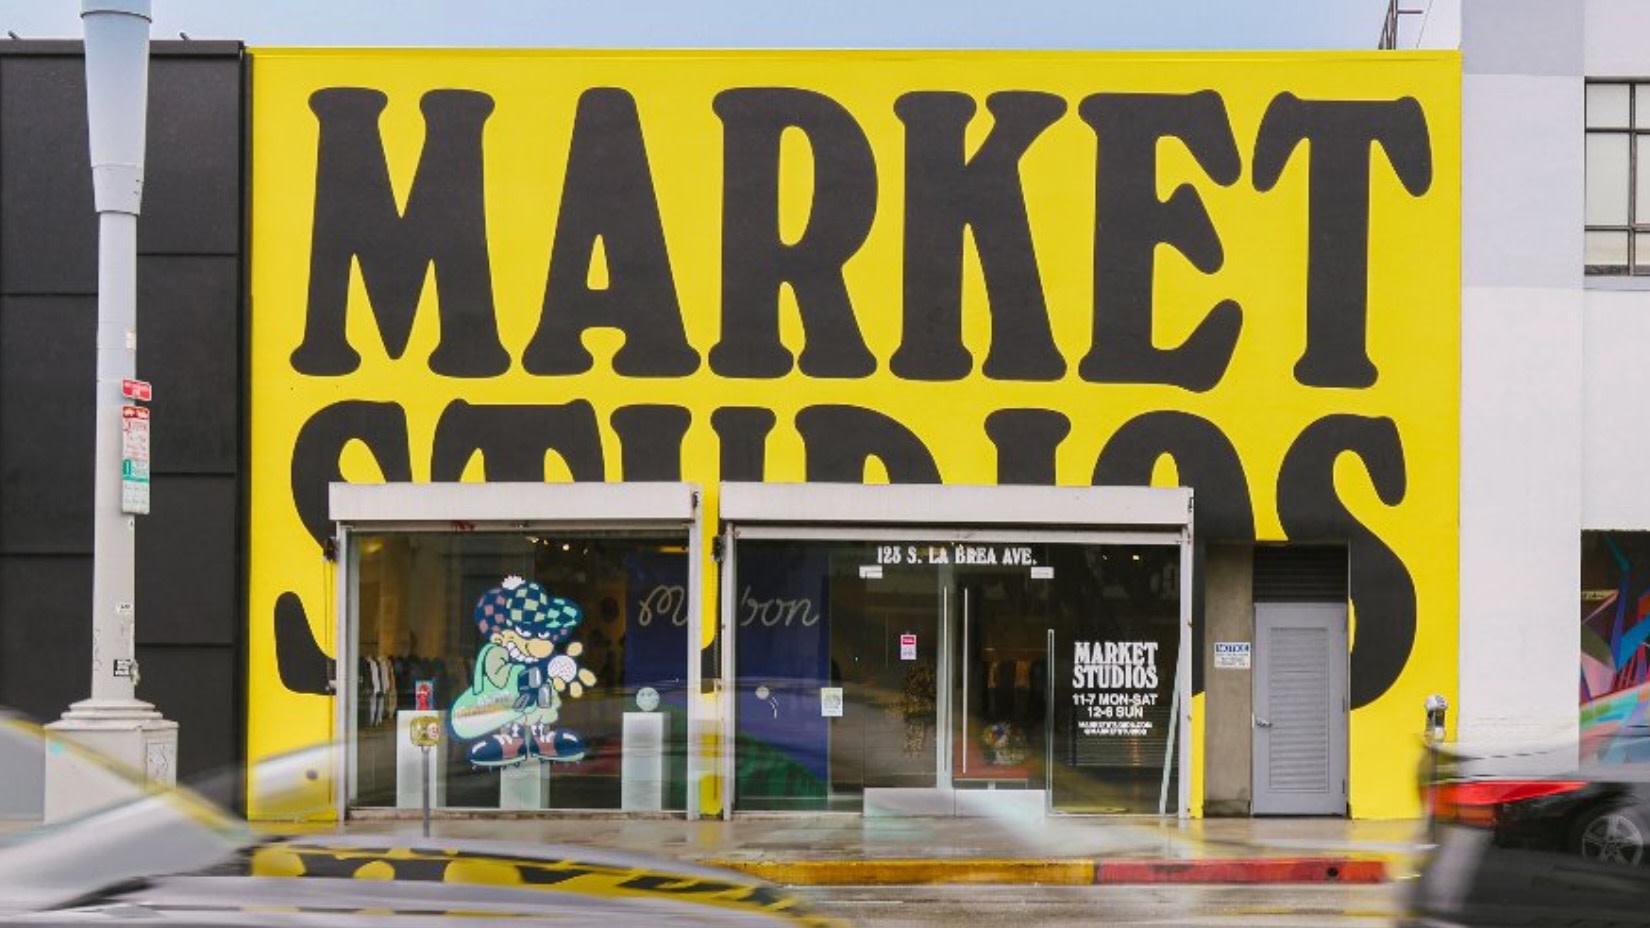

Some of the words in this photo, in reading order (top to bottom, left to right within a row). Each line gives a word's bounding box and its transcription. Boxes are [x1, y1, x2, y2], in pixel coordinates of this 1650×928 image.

[290, 87, 1432, 392] MARKET
[906, 546, 922, 564] S.
[928, 546, 949, 564] LA
[954, 547, 998, 564] BREA
[1002, 547, 1037, 566] AVE.
[638, 585, 820, 627] Mbon
[1074, 641, 1158, 665] MARKET
[1072, 664, 1159, 689] STUDIOS
[1072, 693, 1096, 705] 11-7
[1098, 692, 1158, 706] MON-SAT
[1115, 706, 1144, 718] SUN
